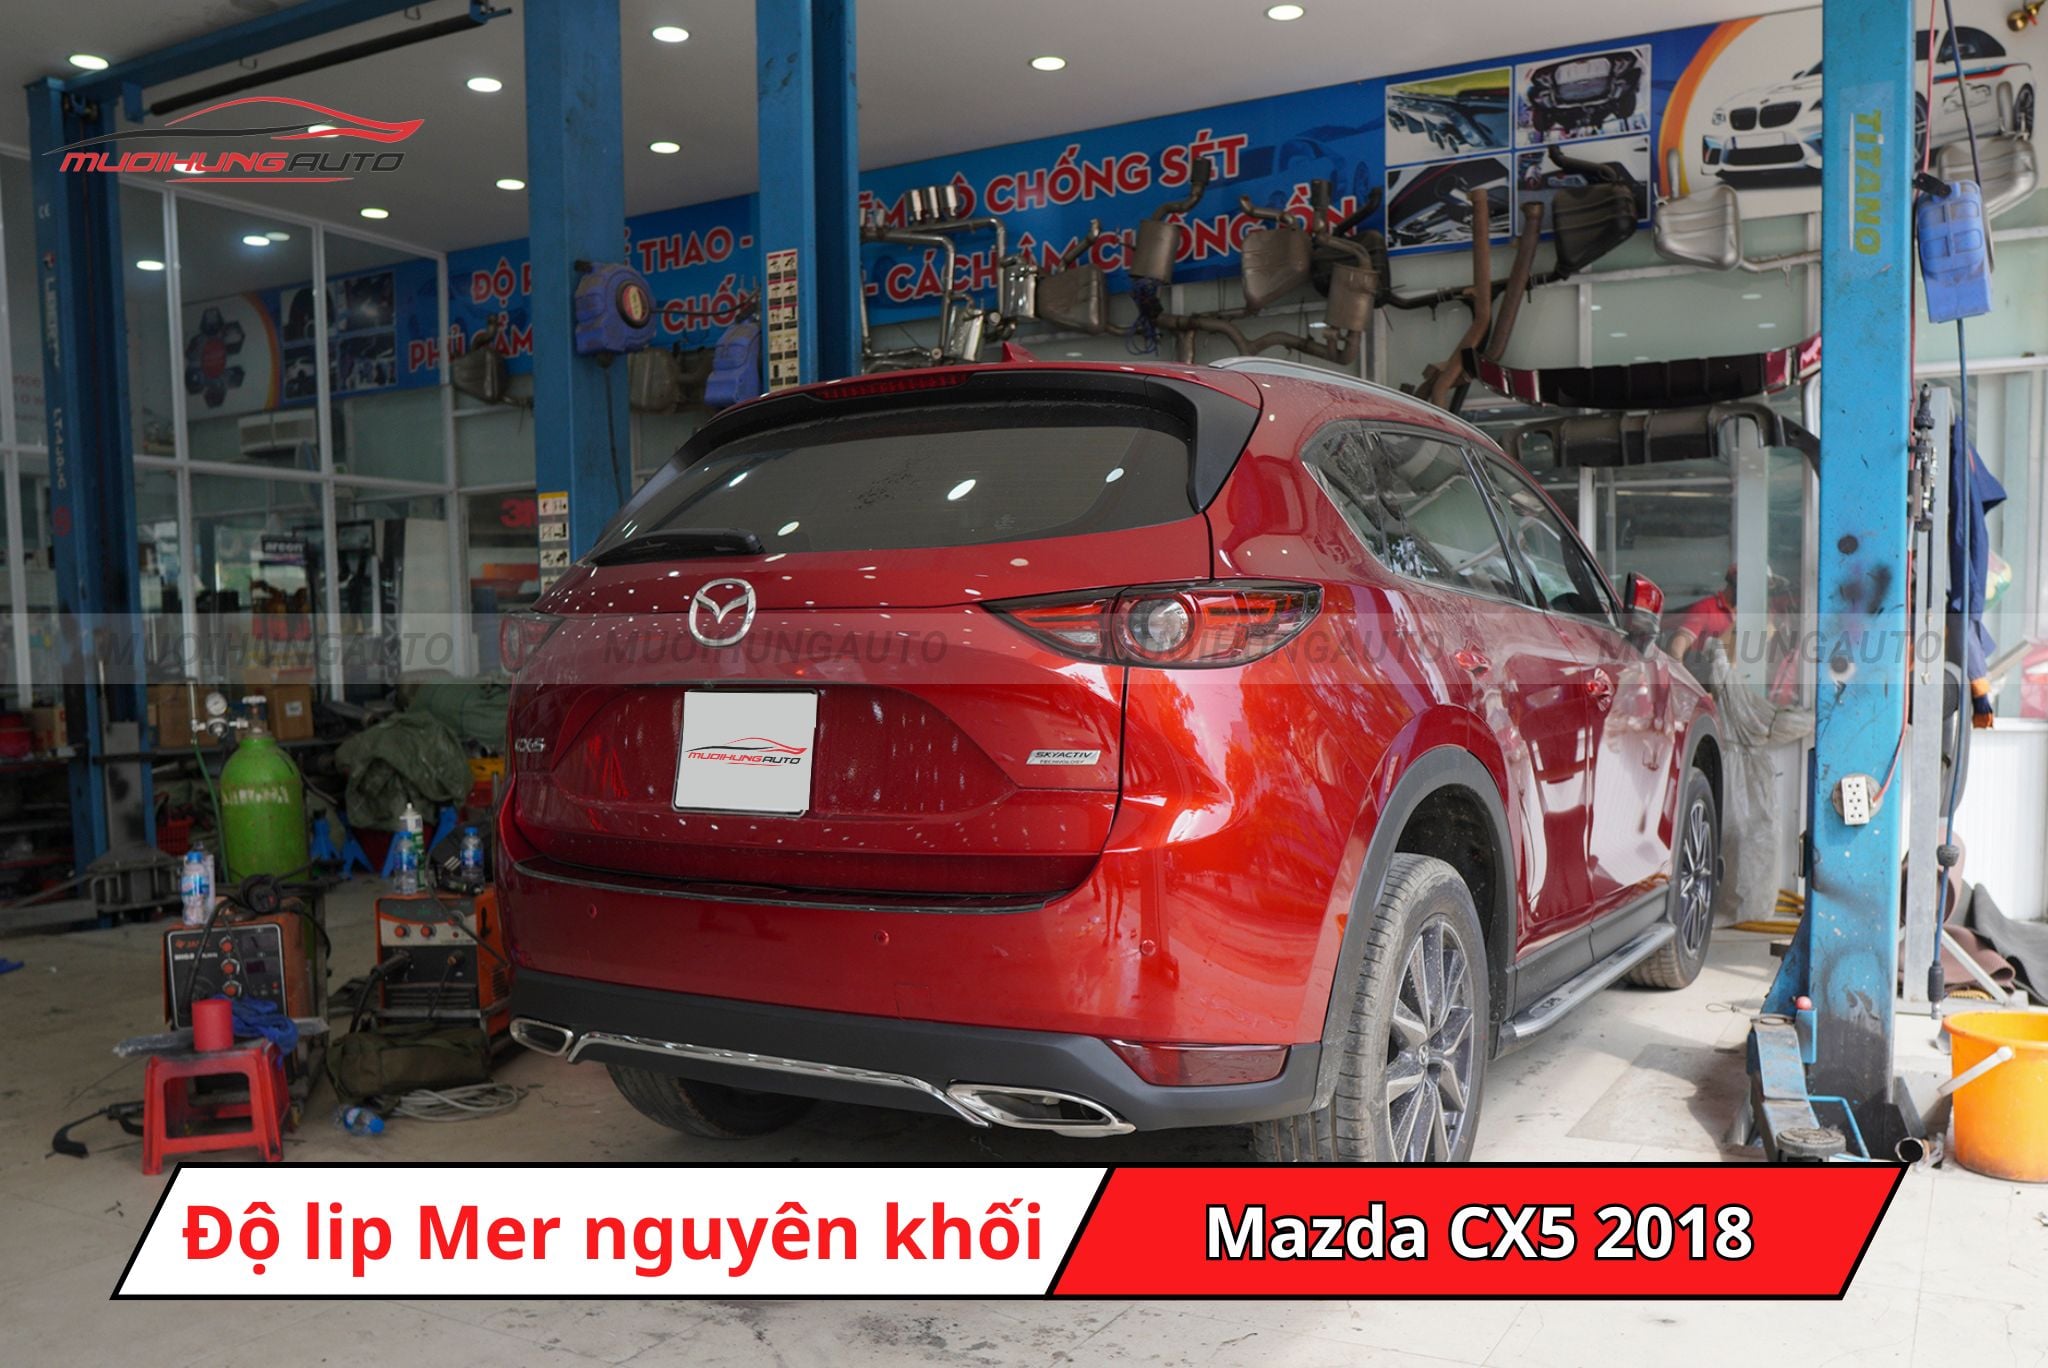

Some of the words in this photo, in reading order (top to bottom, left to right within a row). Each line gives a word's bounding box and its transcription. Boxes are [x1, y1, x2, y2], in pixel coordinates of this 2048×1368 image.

[472, 258, 515, 307] ĐỘ
[638, 226, 734, 274] THAO
[984, 144, 1150, 215] CHỐNG
[1159, 128, 1248, 188] SÉT
[885, 247, 1000, 303] CÁCH
[1034, 751, 1093, 759] SKYACTIV
